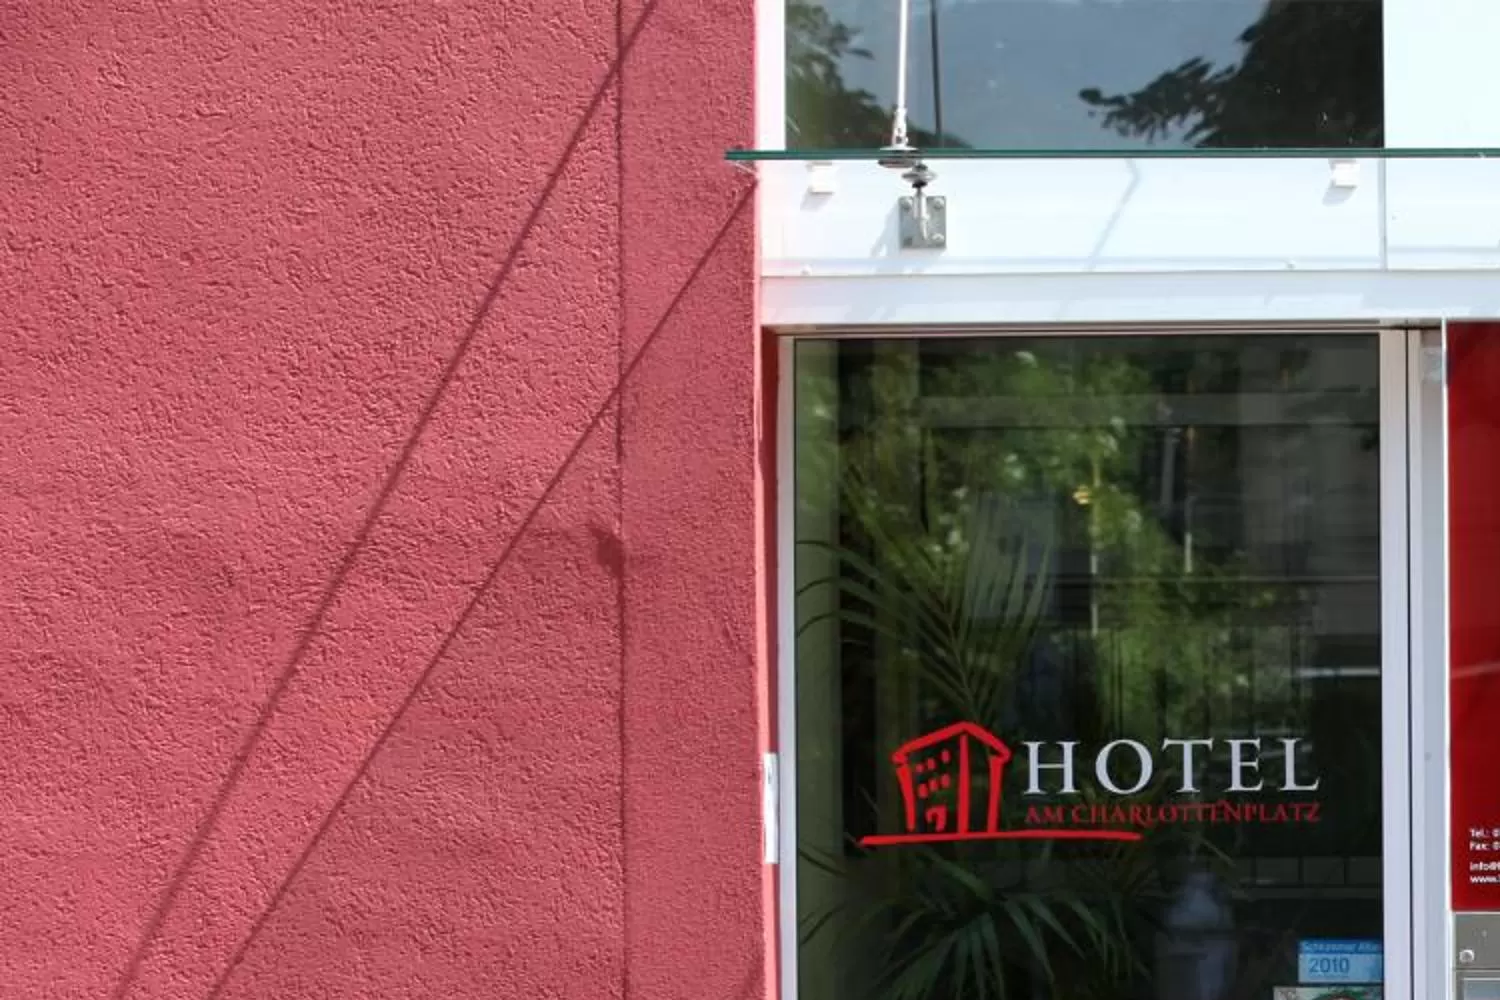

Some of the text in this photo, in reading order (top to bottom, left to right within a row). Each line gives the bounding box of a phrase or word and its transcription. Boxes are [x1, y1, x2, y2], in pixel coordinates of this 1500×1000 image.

[1022, 737, 1321, 796] HOTEL
[1023, 801, 1322, 828] AM CHARLOTTENPLATZ
[1308, 957, 1351, 974] 2010
